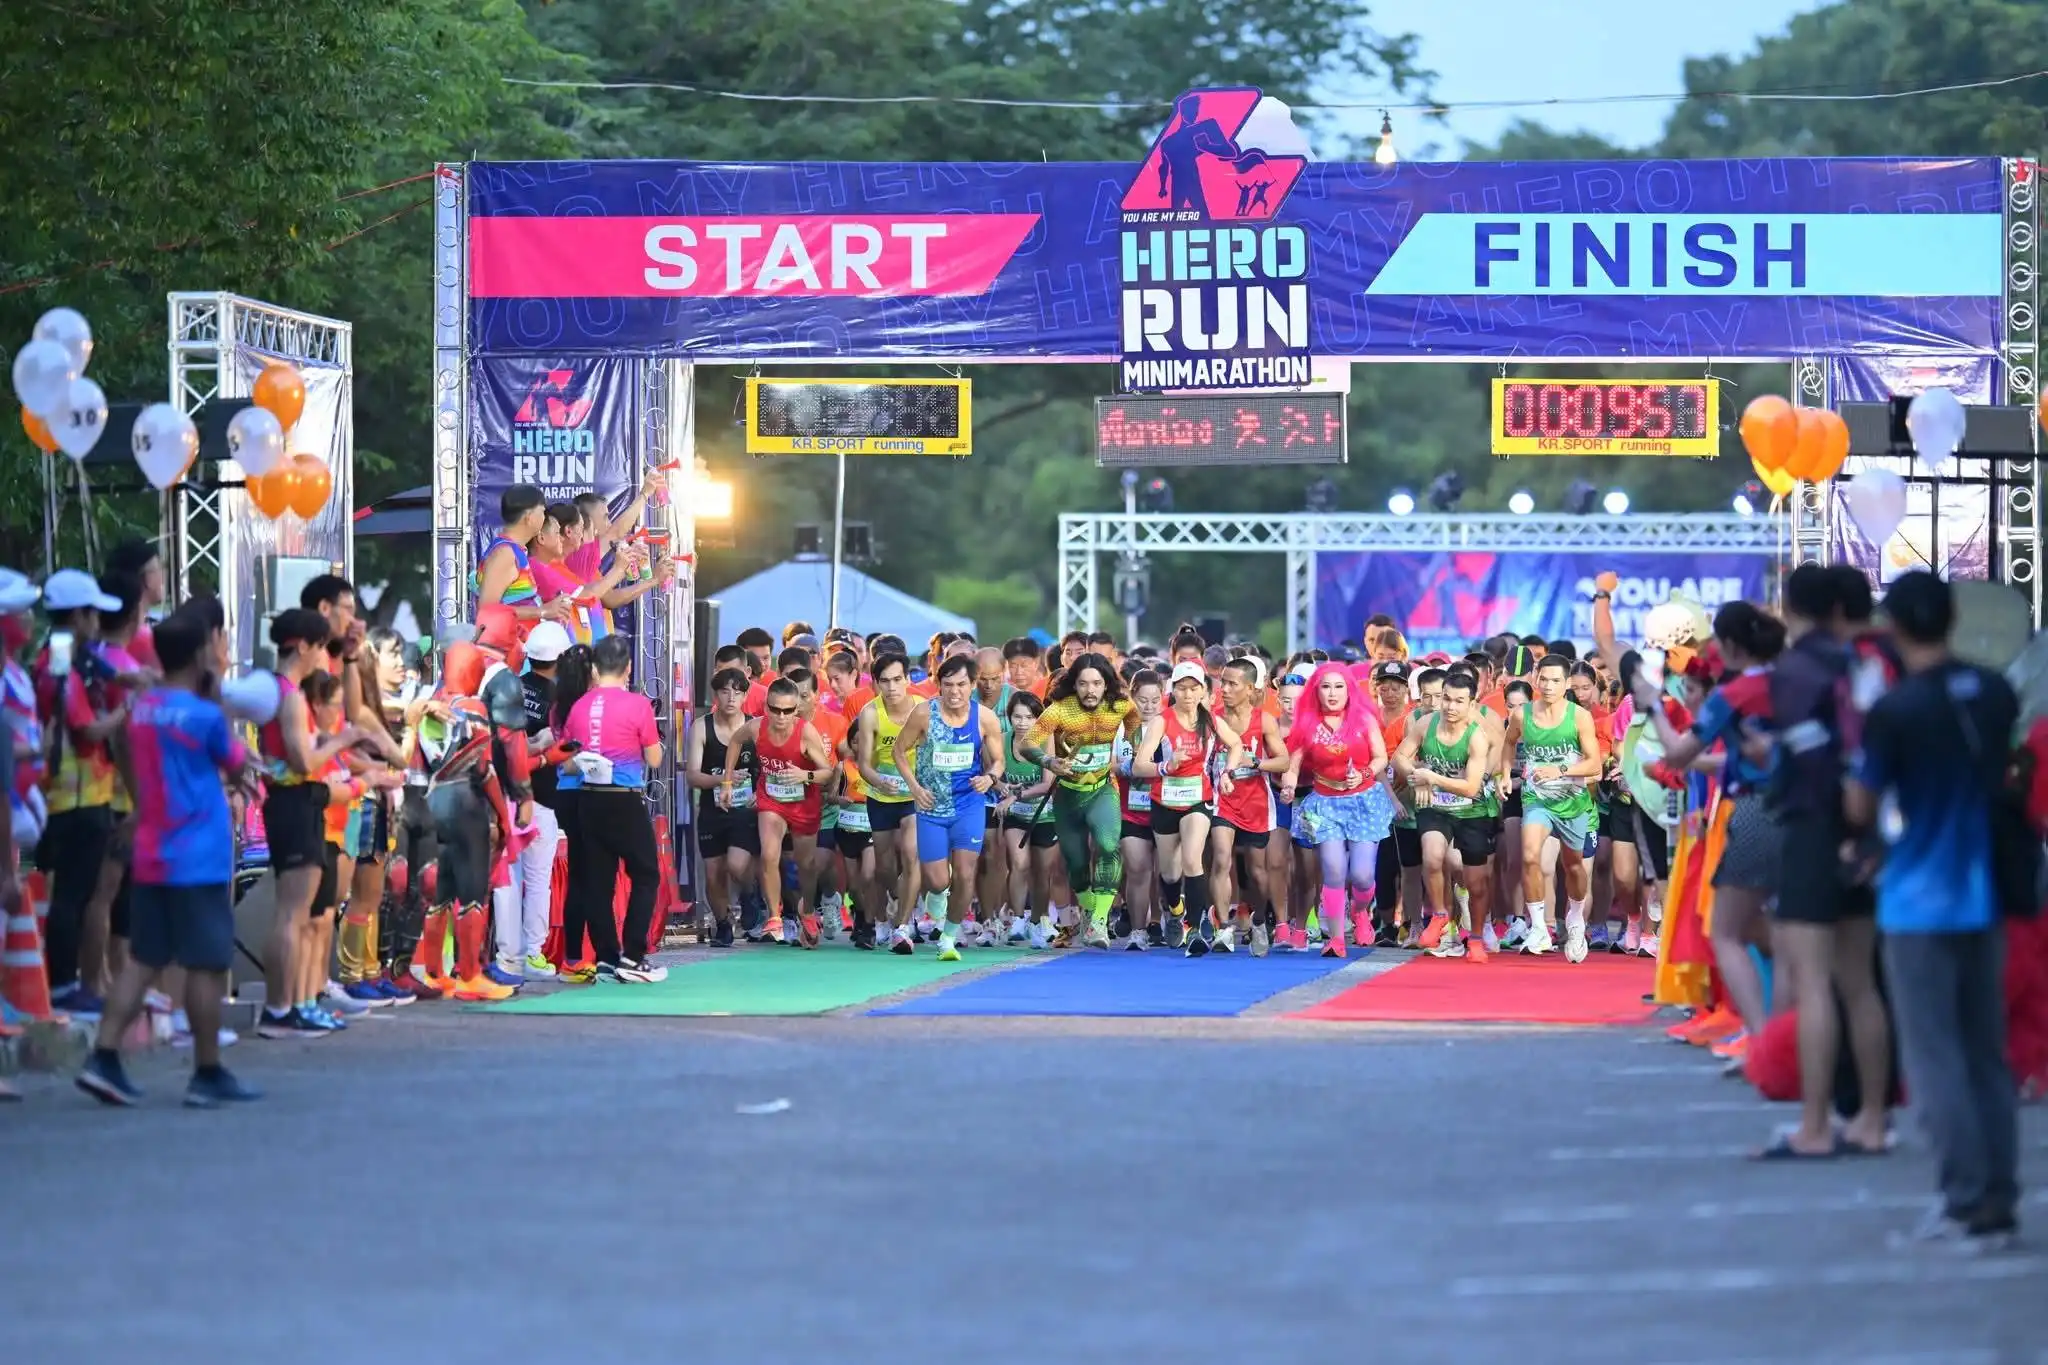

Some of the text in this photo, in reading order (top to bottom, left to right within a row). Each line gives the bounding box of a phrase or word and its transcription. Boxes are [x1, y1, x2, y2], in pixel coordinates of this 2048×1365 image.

[1123, 211, 1200, 224] YOU ARE MY HERO
[644, 223, 947, 290] START
[1121, 227, 1306, 282] HERO
[1475, 222, 1806, 288] FINISH
[1123, 285, 1308, 352] RUN
[1123, 356, 1308, 388] MINIMARATHON
[1505, 384, 1705, 437] 00:09:57
[514, 429, 593, 453] HERO
[792, 438, 924, 453] KR.SPORT running
[1538, 438, 1672, 454] KR.SPORT running
[514, 456, 594, 483] RUN
